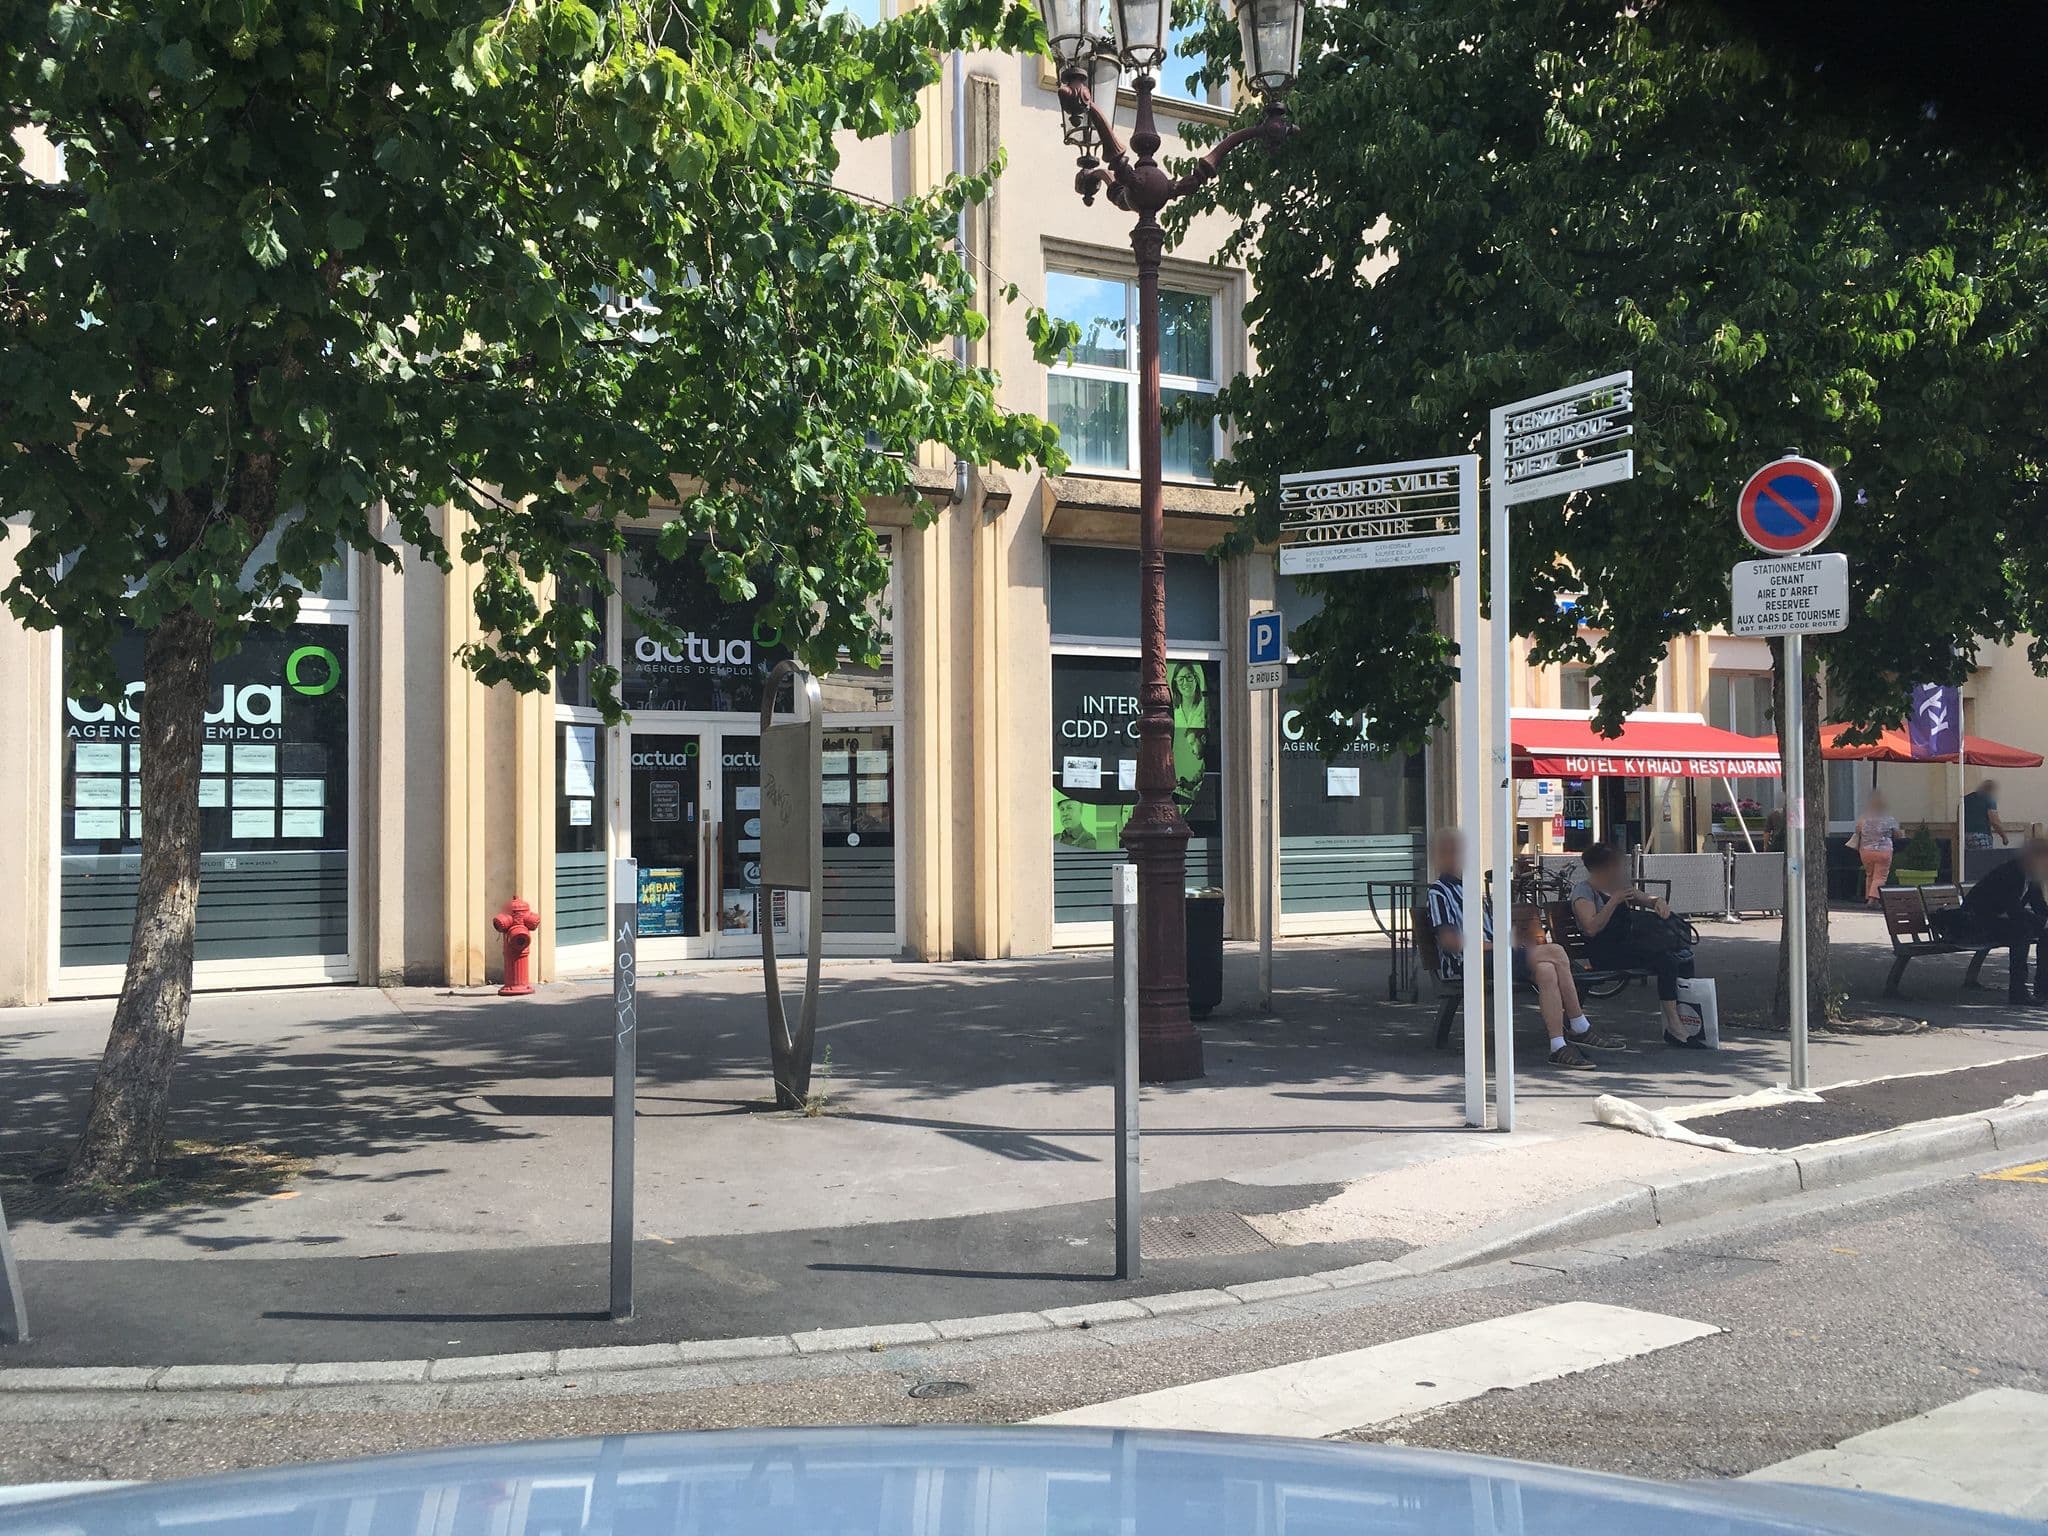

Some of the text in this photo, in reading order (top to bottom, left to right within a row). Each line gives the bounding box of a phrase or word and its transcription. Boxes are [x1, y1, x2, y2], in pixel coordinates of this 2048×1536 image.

[1513, 402, 1578, 433] CENTRE
[1512, 452, 1561, 478] METZ
[1368, 478, 1393, 496] DE
[1395, 471, 1450, 492] VILLE
[1305, 499, 1401, 521] STADTKERN
[1305, 518, 1414, 543] CITY CENTRE
[1753, 560, 1822, 575] STATIONNEMENT
[1770, 574, 1804, 585] GENANT
[1758, 588, 1776, 599] AIRE
[1790, 585, 1818, 597] ARRET
[1765, 598, 1810, 611] RESERVEE
[1737, 608, 1841, 625] AUX CARS DE TOURISME
[1257, 624, 1272, 656] P
[635, 632, 751, 665] actua
[635, 664, 753, 676] AGENCES D'EMPLOI
[1249, 671, 1280, 684] 2 ROUES
[1083, 695, 1143, 715] INTER
[67, 725, 282, 740] AGENC EMPLOI
[1061, 719, 1108, 738] CDD
[1283, 742, 1321, 752] AGENC
[631, 750, 687, 766] actua
[723, 751, 760, 767] actu
[1566, 757, 1782, 775] HOTEL KYRIAD RESTAURANT
[642, 882, 676, 893] URBAN
